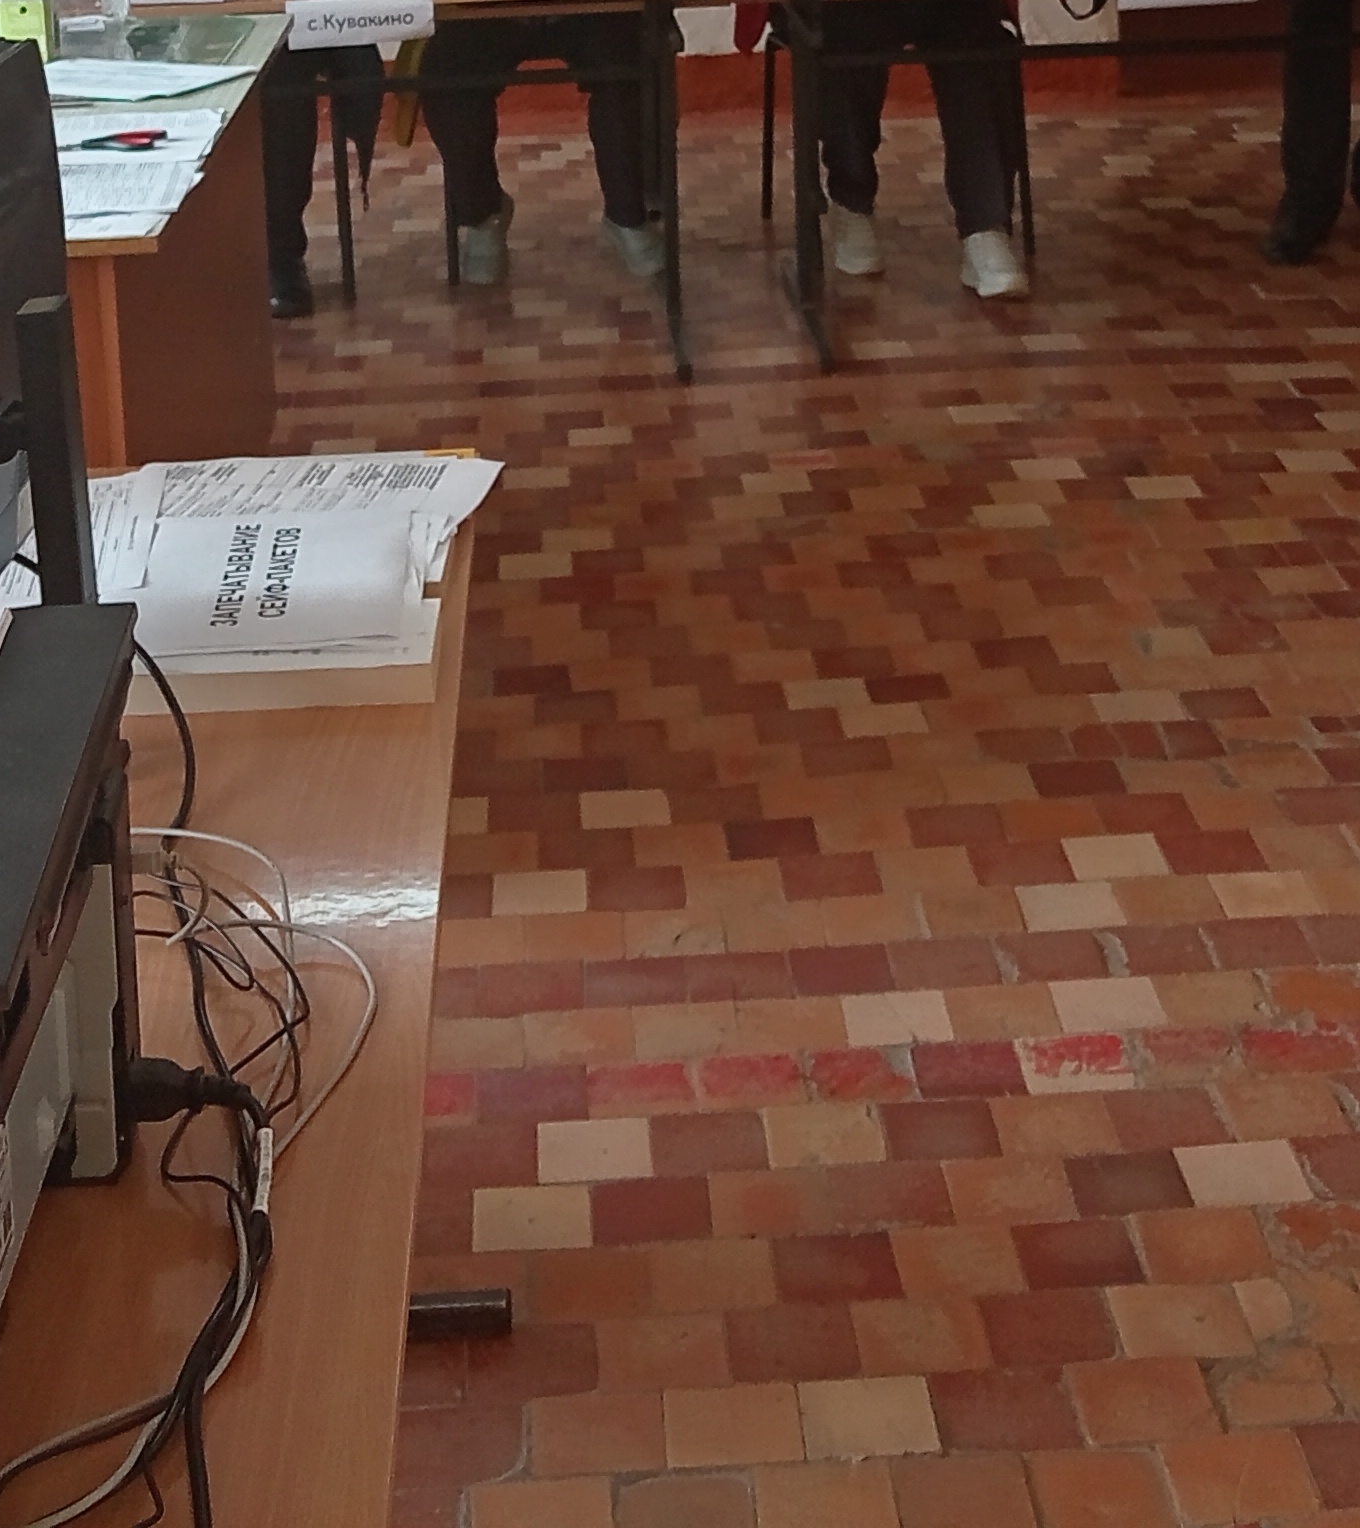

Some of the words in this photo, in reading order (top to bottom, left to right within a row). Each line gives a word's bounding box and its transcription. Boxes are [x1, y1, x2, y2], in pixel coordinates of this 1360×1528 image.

[308, 13, 414, 33] с.Кувакино
[210, 523, 262, 627] ЗАПЕЧАТЫВАНИЕ
[256, 527, 302, 618] СЕЙФ-ПАКЕТОВ
